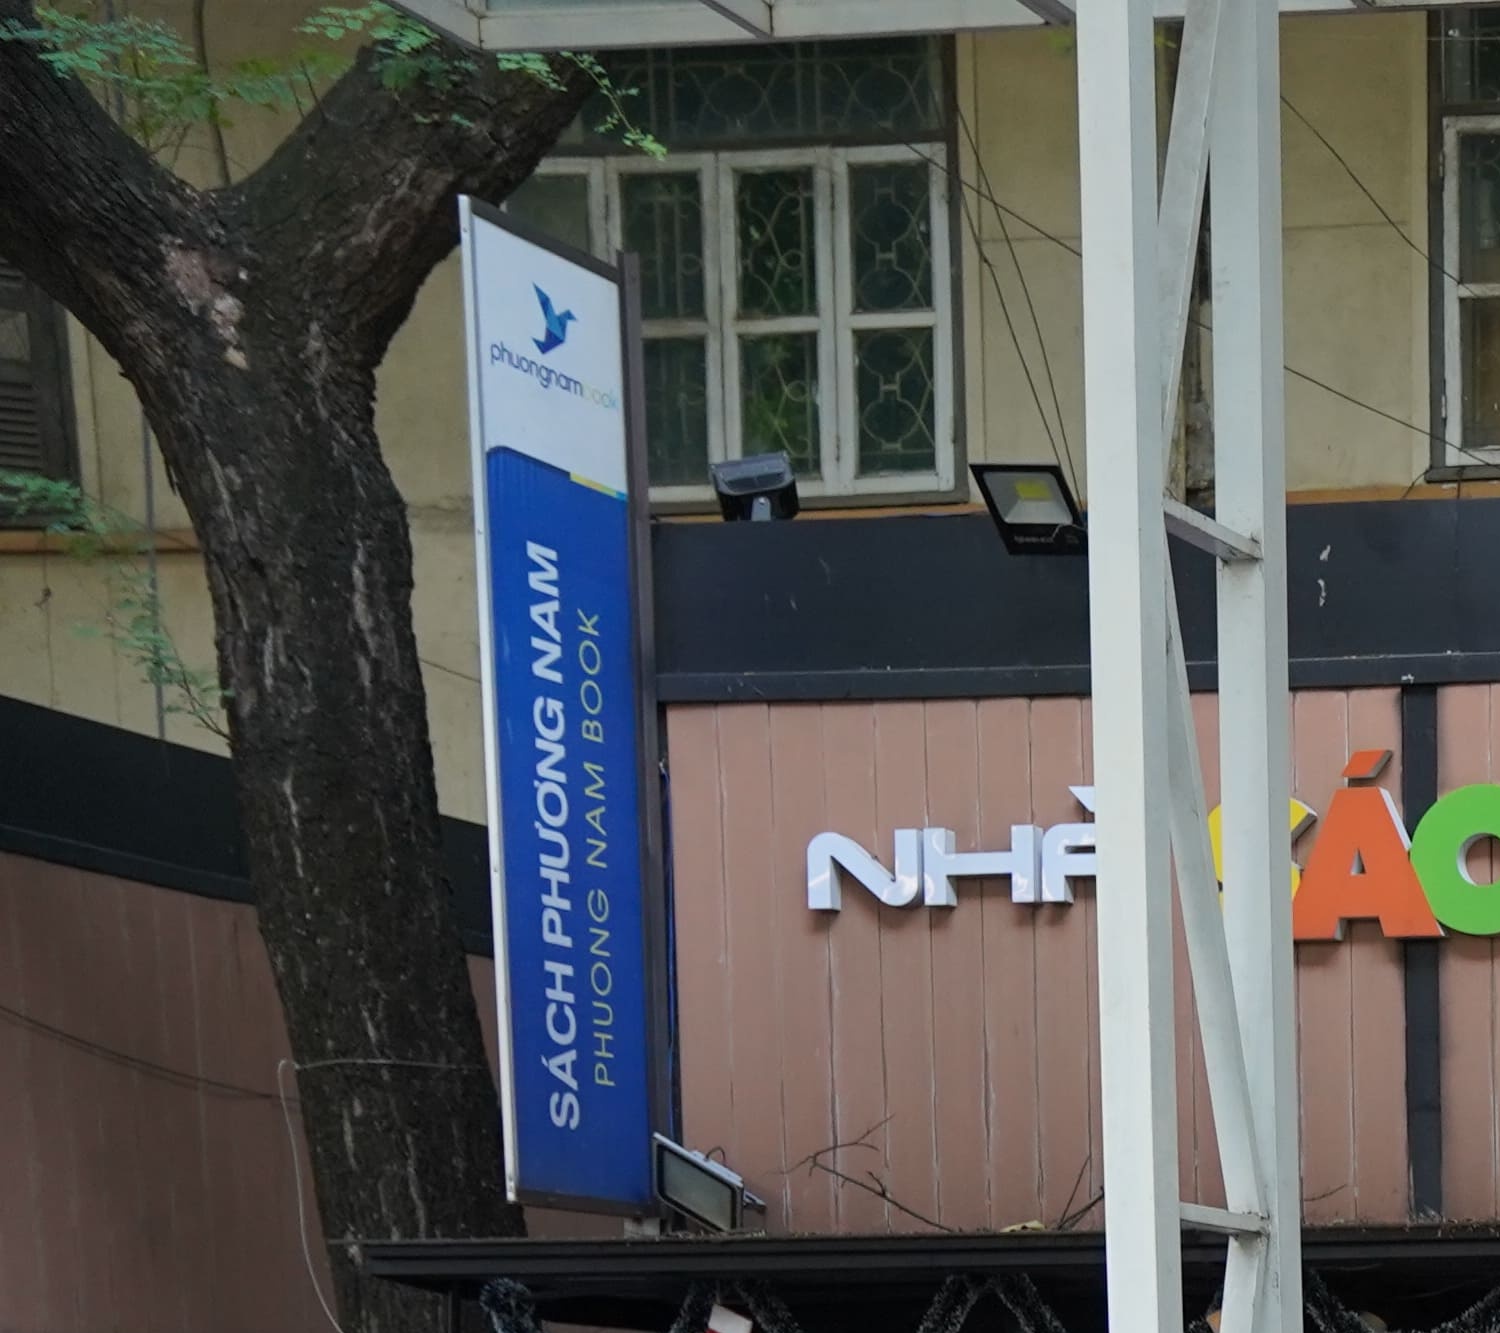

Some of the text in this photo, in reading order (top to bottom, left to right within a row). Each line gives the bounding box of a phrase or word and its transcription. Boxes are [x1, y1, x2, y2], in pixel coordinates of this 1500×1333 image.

[526, 540, 580, 1130] SÁCH PHƯƠNG NAM
[577, 608, 616, 1087] PHUONG NAM BOOK
